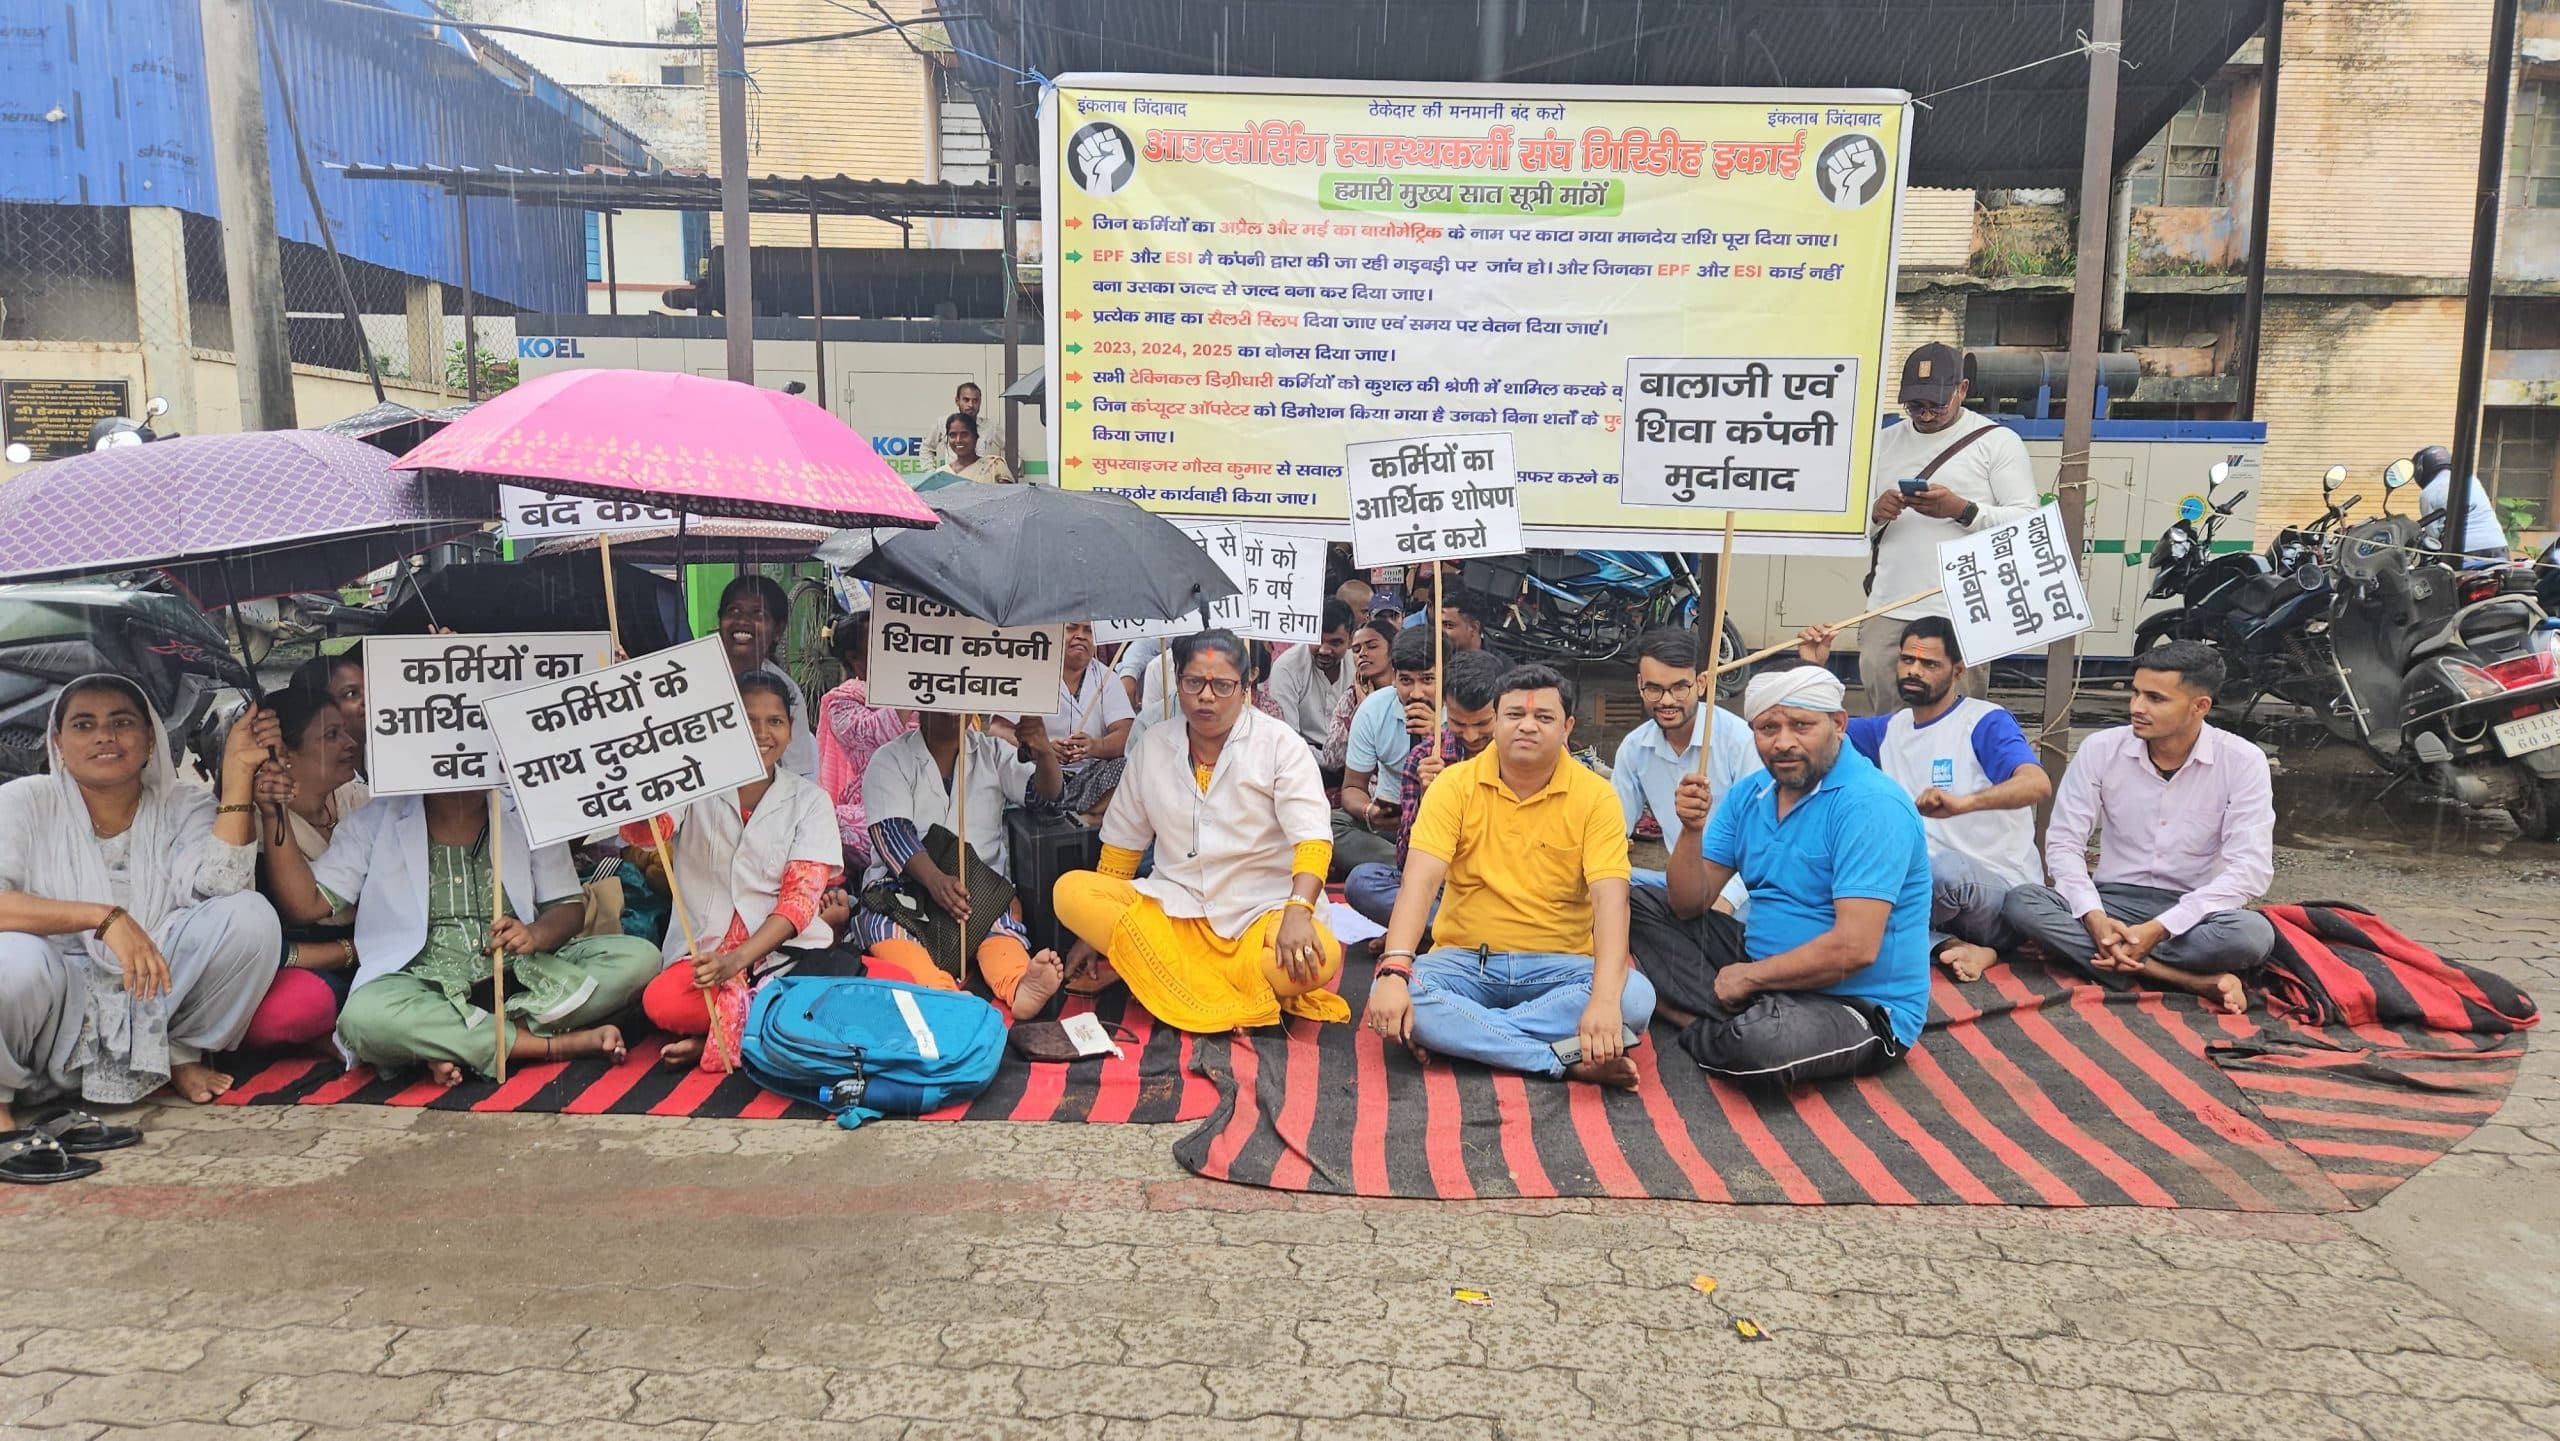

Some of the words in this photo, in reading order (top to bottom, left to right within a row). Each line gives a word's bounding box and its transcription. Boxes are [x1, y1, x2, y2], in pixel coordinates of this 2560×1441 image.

[1077, 97, 1127, 114] इंकलाब
[1134, 99, 1188, 116] जिंदाबाद
[1369, 100, 1416, 118] ठेकेदार
[1423, 102, 1442, 118] की
[1450, 103, 1504, 119] मनमानी
[1511, 104, 1530, 121] बंद
[1536, 104, 1566, 121] करो
[1767, 109, 1819, 126] इंकलाब
[1826, 110, 1882, 127] जिंदाबाद
[1143, 120, 1329, 167] आउटसोर्सिंग
[1334, 125, 1515, 170] स्वास्थ्यकर्मी
[1519, 126, 1574, 173] संघ
[1582, 127, 1707, 177] गिरिडीह
[1713, 129, 1807, 179] इकाई
[1334, 177, 1393, 203] हमारी
[1399, 183, 1454, 209] मुख्य
[1459, 185, 1505, 204] सात
[1509, 180, 1554, 211] सूत्री
[1560, 181, 1609, 206] मांगें
[1093, 214, 1127, 230] जिन
[1133, 216, 1190, 232] कर्मियों
[1193, 222, 1216, 233] का
[1267, 219, 1298, 235] और
[1334, 226, 1356, 237] का
[1448, 224, 1466, 240] के
[1471, 228, 1504, 241] नाम
[1509, 230, 1530, 241] पर
[1536, 230, 1574, 242] काटा
[1579, 232, 1613, 243] गया
[1618, 228, 1676, 245] मानदेय
[1682, 229, 1717, 245] राशि
[1722, 233, 1750, 250] पूरा
[1755, 229, 1792, 246] दिया
[1796, 234, 1837, 247] जाए।
[1093, 250, 1125, 262] EPF
[1130, 248, 1162, 264] और
[1166, 251, 1193, 264] ESI
[1218, 250, 1266, 267] कंपनी
[1307, 252, 1330, 269] की
[1334, 258, 1357, 269] जा
[1362, 254, 1388, 271] रही
[1456, 261, 1477, 272] पर
[1487, 259, 1522, 273] जांच
[1557, 258, 1588, 276] और
[1593, 259, 1652, 276] जिनका
[1658, 263, 1691, 276] EPF
[1696, 261, 1729, 278] और
[1735, 265, 1762, 277] ESI
[1769, 263, 1805, 280] कार्ड
[1809, 263, 1844, 280] नहीं
[1093, 280, 1121, 292] बना
[1127, 281, 1174, 294] उसका
[1180, 282, 1217, 295] जल्द
[1223, 281, 1238, 295] से
[1243, 284, 1279, 296] जल्द
[1284, 285, 1315, 298] बना
[1320, 287, 1347, 299] कर
[1352, 283, 1387, 300] दिया
[1392, 288, 1432, 302] जाए।
[1093, 308, 1140, 323] प्रत्येक
[1145, 312, 1176, 324] माह
[1181, 312, 1203, 325] का
[1304, 312, 1338, 329] दिया
[1344, 317, 1375, 330] जाए
[1381, 315, 1407, 331] एवं
[1409, 319, 1451, 332] समय
[1457, 320, 1478, 333] पर
[1482, 317, 1520, 333] वेतन
[1526, 318, 1561, 334] दिया
[518, 337, 585, 359] KOEL
[1093, 342, 1136, 356] 2023,
[1142, 342, 1187, 357] 2024,
[1193, 344, 1232, 357] 2025
[1238, 346, 1259, 358] का
[1315, 344, 1350, 360] दिया
[1355, 348, 1396, 361] जाए।
[1093, 368, 1125, 383] सभी
[1130, 369, 1202, 386] टेक्निकल
[1206, 371, 1274, 388] डिग्रीधारी
[1278, 373, 1334, 389] कर्मियों
[1338, 374, 1360, 390] को
[1365, 379, 1413, 397] कुशल
[1417, 377, 1439, 392] की
[1444, 378, 1480, 394] श्रेणी
[1484, 379, 1502, 394] में
[1504, 379, 1559, 395] शामिल
[1563, 381, 1608, 396] करके
[1640, 362, 1772, 400] बालाजी
[1782, 363, 1846, 400] एवं
[1093, 397, 1126, 412] जिन
[1131, 399, 1185, 419] कंप्यूटर
[1190, 400, 1250, 416] ऑपरेटर
[1254, 402, 1276, 417] को
[1281, 401, 1345, 419] डिमोशन
[1350, 404, 1390, 420] किया
[1395, 409, 1427, 421] गया
[1432, 406, 1449, 422] है
[1450, 408, 1496, 423] उनको
[1544, 410, 1579, 425] शर्तों
[1581, 410, 1599, 425] के
[1636, 408, 1716, 443] शिवा
[1725, 410, 1839, 447] कंपनी
[872, 437, 925, 456] KOE
[1093, 426, 1130, 441] किया
[1135, 431, 1174, 443] जाए।
[1092, 458, 1179, 474] सुपरवाइजर
[1183, 458, 1222, 473] गौरव
[1227, 462, 1273, 479] कुमार
[1277, 461, 1291, 475] से
[1296, 464, 1342, 477] सवाल
[1558, 469, 1597, 484] करने
[1370, 443, 1459, 479] कर्मियों
[1462, 448, 1494, 471] का
[1161, 486, 1227, 503] कार्यवाही
[1233, 488, 1272, 503] किया
[1277, 493, 1316, 505] जाए।
[1665, 456, 1800, 502] मुर्दाबाद
[519, 493, 582, 527] बंद
[1355, 484, 1444, 520] आर्थिक
[1452, 481, 1515, 511] शोषण
[1216, 527, 1237, 556] से
[1396, 523, 1437, 554] बंद
[1443, 518, 1487, 549] करो
[1991, 526, 2019, 560] शिवा
[2027, 513, 2067, 577] बालाजी
[1271, 541, 1297, 570] को
[1265, 573, 1294, 600] वर्ष
[1946, 552, 1991, 624] मुर्दाबाद
[1998, 560, 2043, 635] कंपनी
[2044, 580, 2084, 621] एवं
[1279, 605, 1318, 634] होगा
[882, 622, 954, 655] शिवा
[962, 630, 1052, 661] कंपनी
[402, 644, 529, 684] कर्मियों
[535, 653, 584, 679] का
[526, 671, 645, 734] कर्मियों
[650, 659, 689, 699] के
[908, 667, 1022, 704] मुर्दाबाद
[431, 743, 488, 779] बंद
[513, 749, 586, 789] साथ
[591, 702, 740, 781] दुर्व्यवहार
[578, 781, 632, 818] बंद
[638, 755, 706, 804] करो
